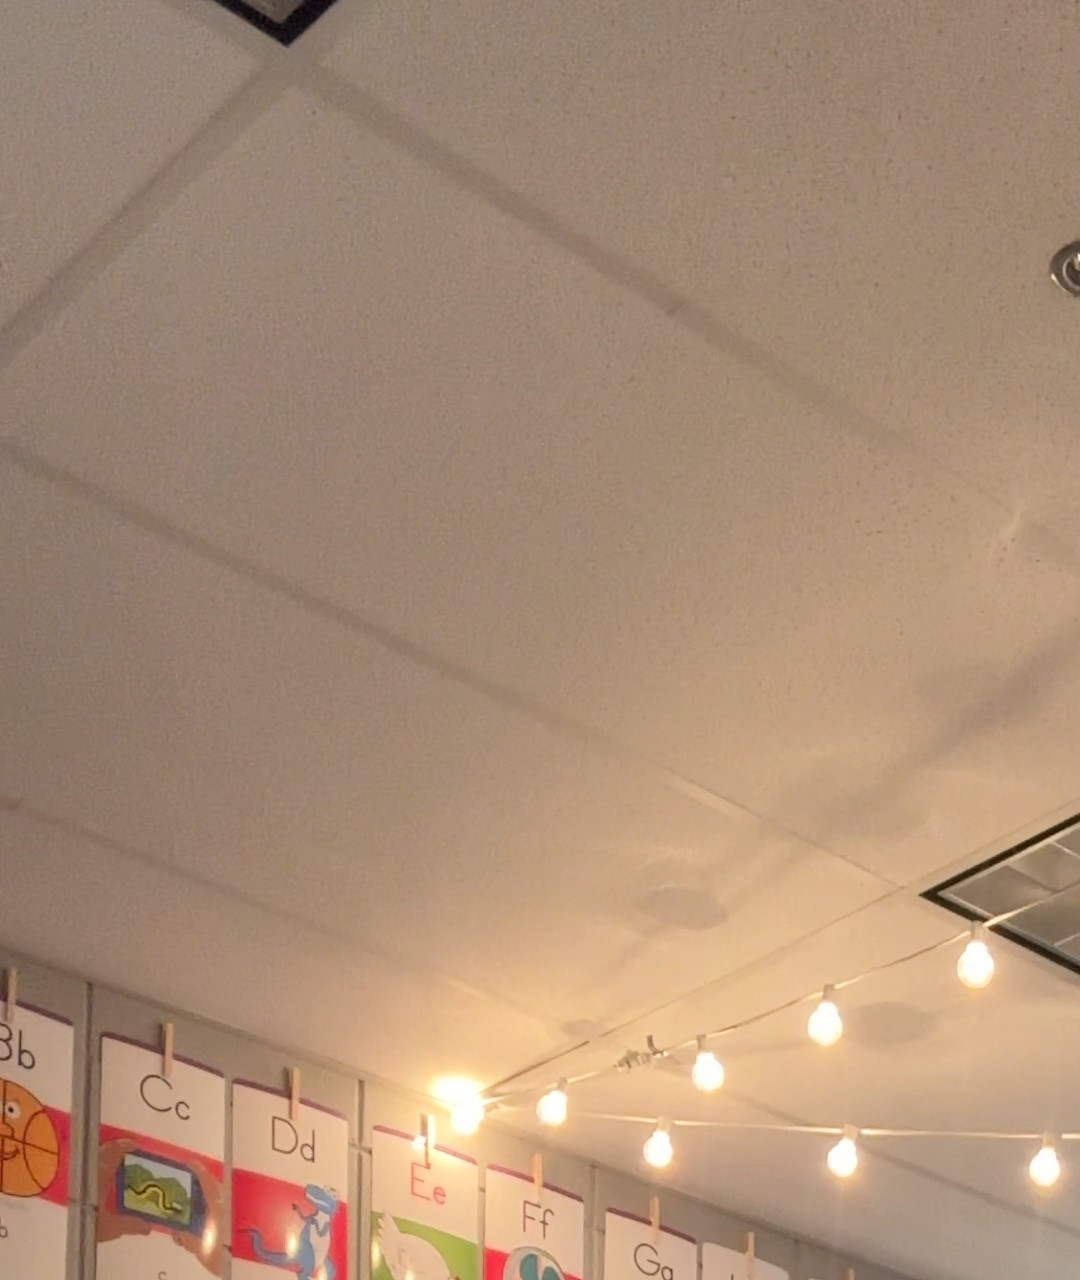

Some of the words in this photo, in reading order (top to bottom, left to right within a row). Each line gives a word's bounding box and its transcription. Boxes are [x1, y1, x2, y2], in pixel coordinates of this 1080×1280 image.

[139, 1073, 192, 1121] Cc
[271, 1116, 317, 1164] Dd
[410, 1161, 447, 1205] Ee
[522, 1200, 555, 1240] Ff
